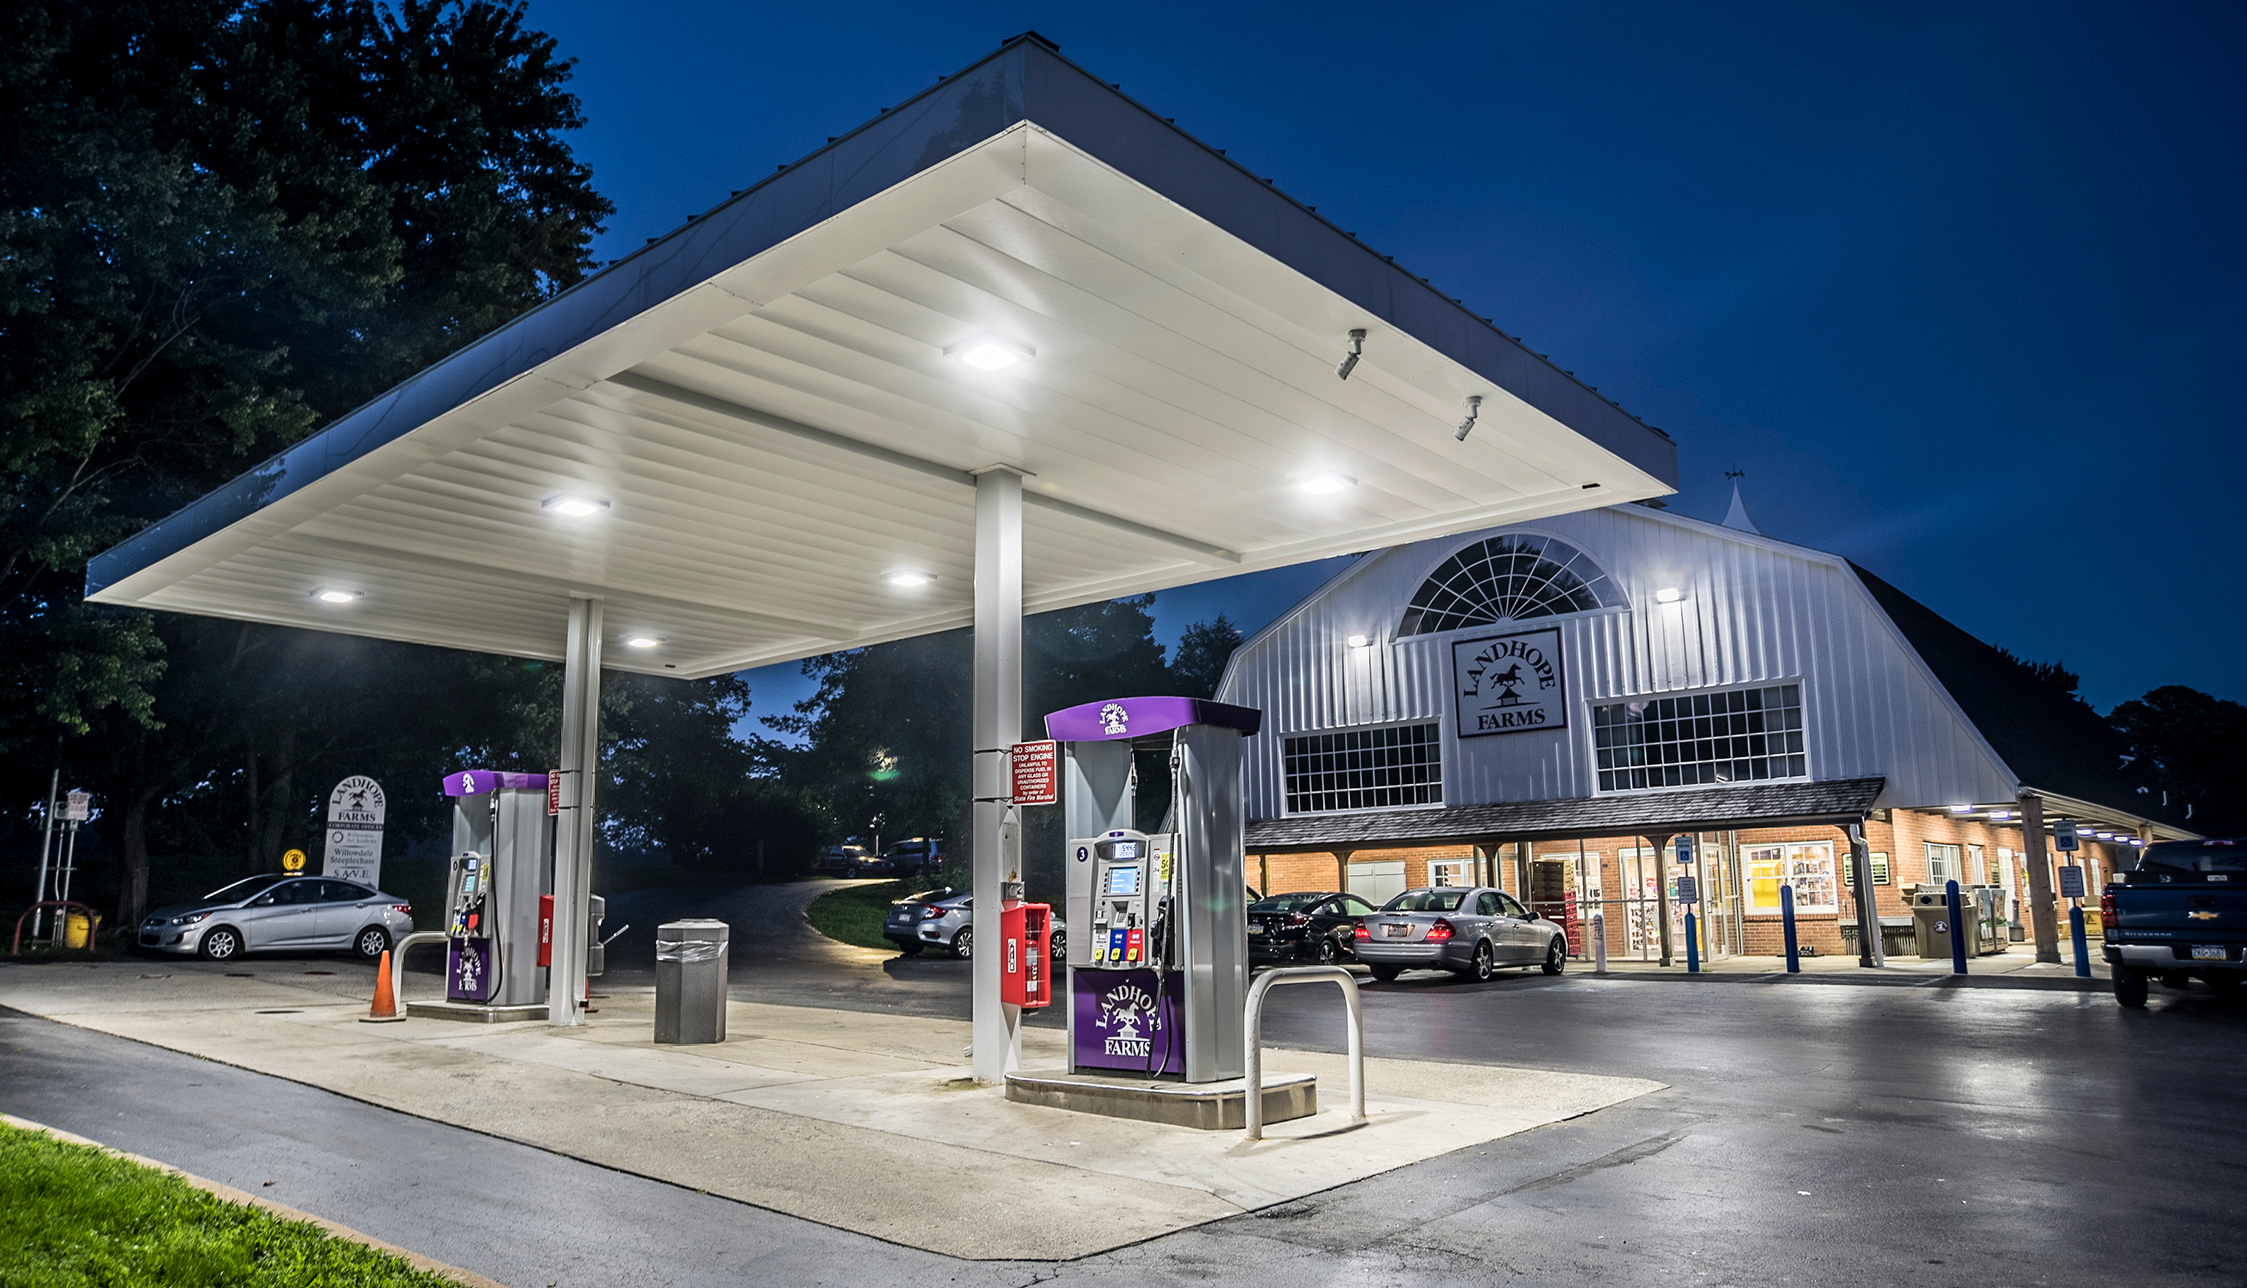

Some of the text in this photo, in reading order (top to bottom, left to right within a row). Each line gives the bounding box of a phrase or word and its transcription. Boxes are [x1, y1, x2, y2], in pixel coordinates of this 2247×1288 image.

[1463, 640, 1556, 698] LANDHOPE
[1099, 703, 1129, 724] LANDHOPE
[1477, 708, 1546, 731] FARMS
[1105, 725, 1127, 735] FARMS
[1013, 744, 1053, 754] NO SMOKING
[1013, 752, 1053, 762] STOP ENGINE
[332, 778, 383, 809] LANDHOPE
[338, 812, 376, 822] FARMS
[334, 848, 374, 857] Willowdale
[1079, 849, 1085, 860] 3
[330, 856, 375, 865] Steeplechase
